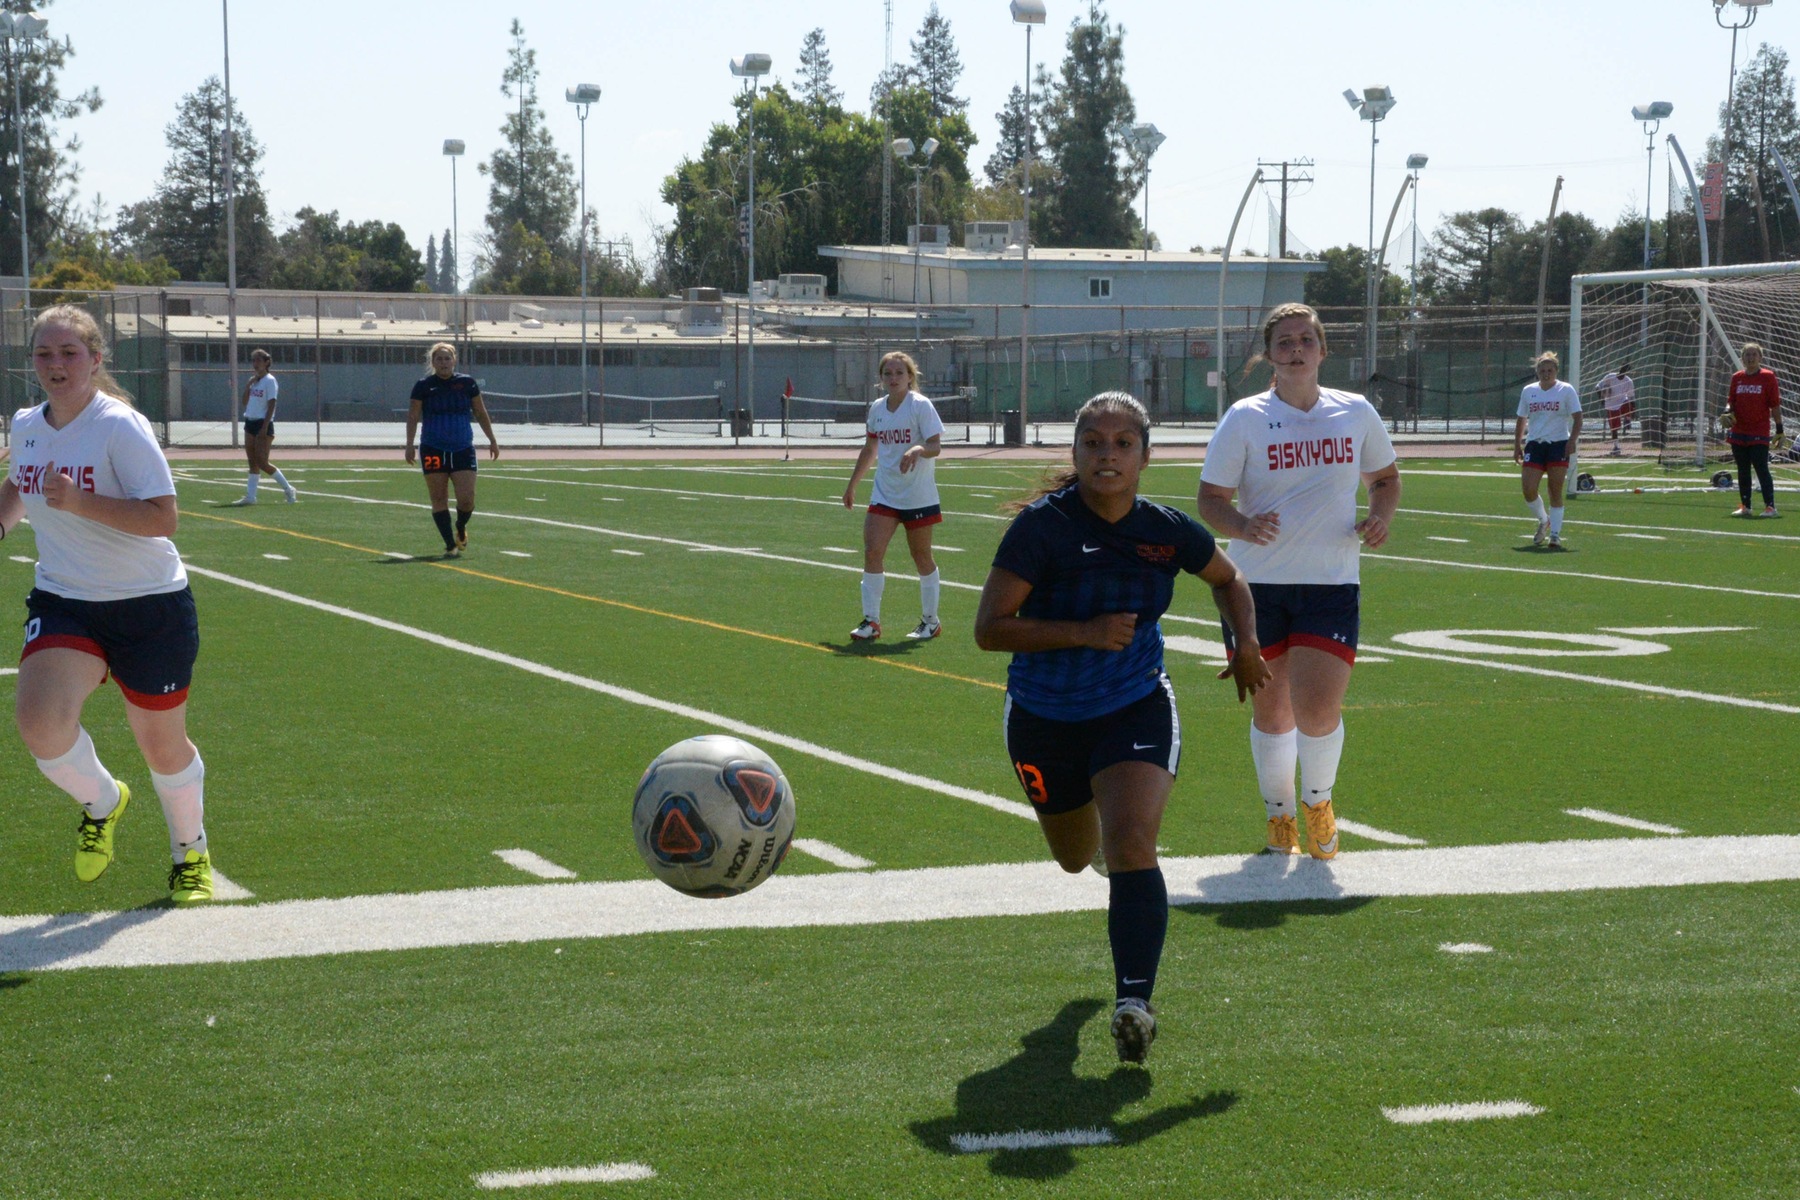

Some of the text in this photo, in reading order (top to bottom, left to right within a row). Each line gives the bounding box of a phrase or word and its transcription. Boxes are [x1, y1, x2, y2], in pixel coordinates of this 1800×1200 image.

[424, 455, 441, 470] 23
[1267, 437, 1354, 471] SISKIYOUS
[1015, 761, 1049, 804] 13
[723, 838, 752, 879] NCAA
